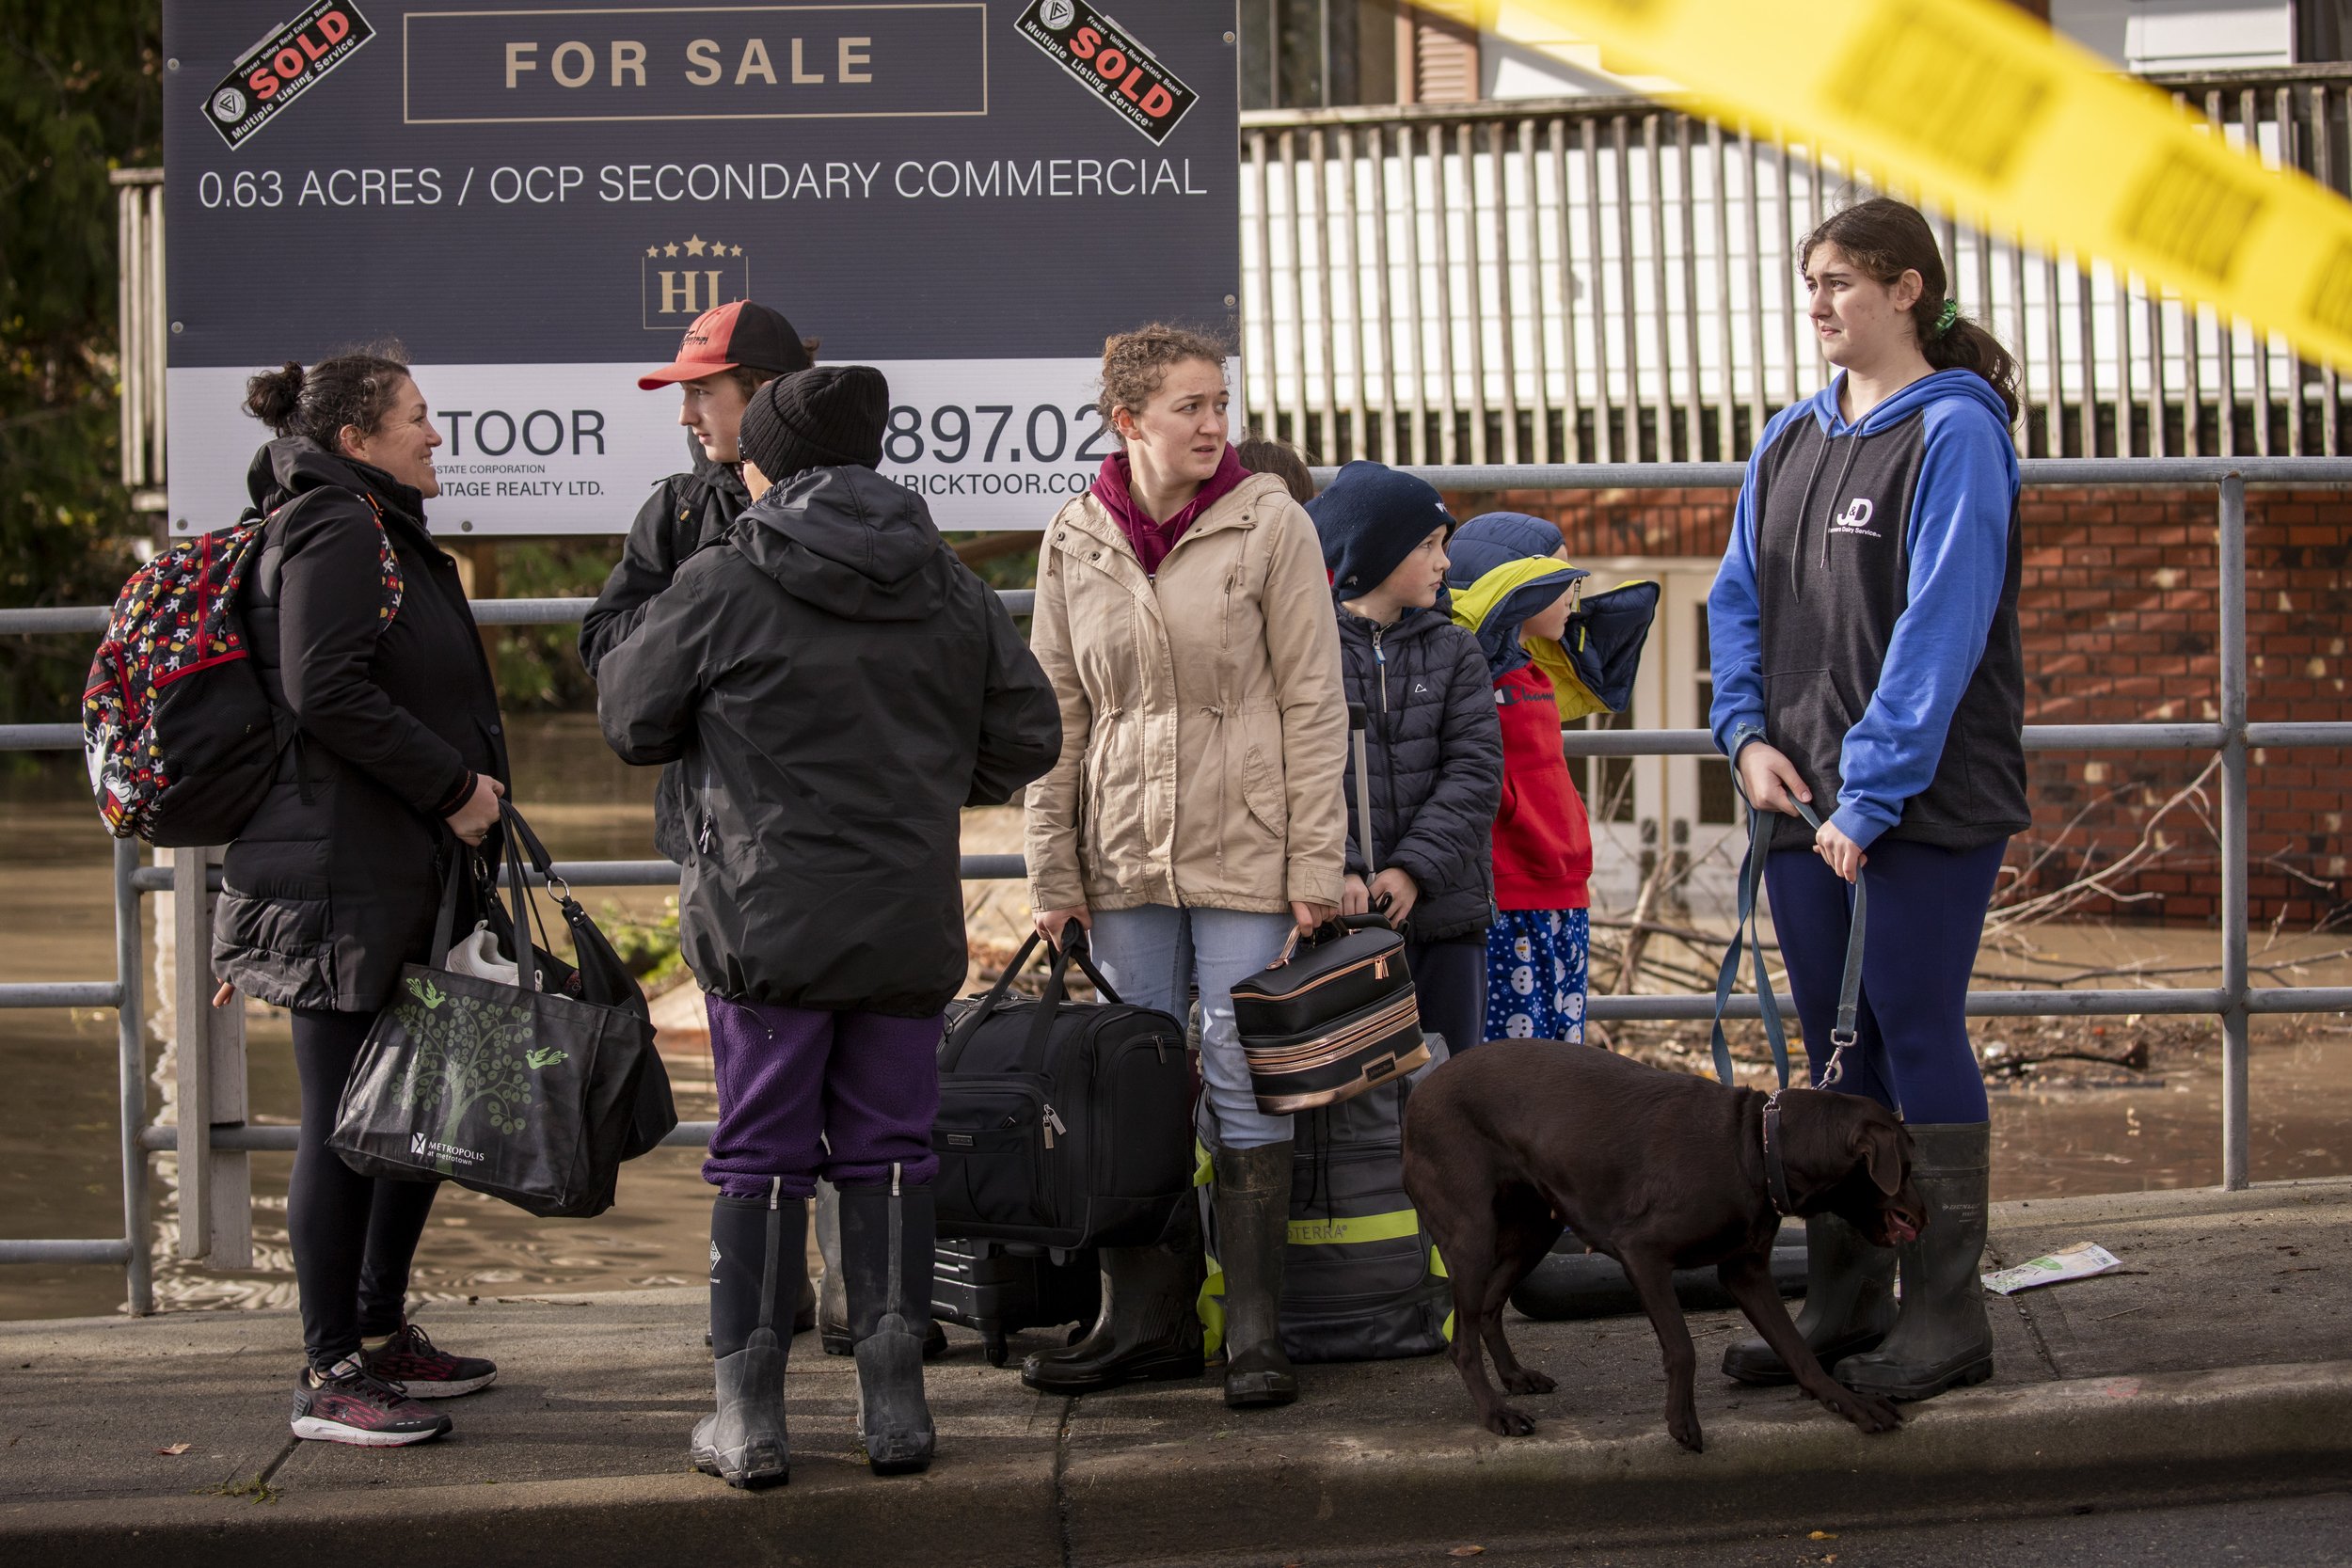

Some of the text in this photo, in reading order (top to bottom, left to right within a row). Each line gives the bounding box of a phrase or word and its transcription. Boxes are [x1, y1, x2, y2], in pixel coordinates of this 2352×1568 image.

[239, 1, 333, 79] Fraser Valley Real Estate Board
[248, 10, 350, 100] SOLD
[505, 37, 873, 88] FOR SALE
[1025, 20, 1068, 59] Multiple
[1071, 58, 1108, 93] Listing
[1087, 15, 1108, 35] Fraser
[1108, 33, 1128, 51] Valley
[1126, 48, 1142, 64] Real
[1141, 59, 1163, 80] Estate
[1162, 77, 1183, 96] Board
[1069, 26, 1173, 118] SOLD
[231, 103, 275, 140] Multiple
[276, 70, 314, 103] Listing
[199, 158, 1207, 208] 0.63 ACRES / OCP SECONDARY COMMERCIAL
[437, 409, 605, 456] TOOR
[433, 464, 546, 474] STATE CORPORATION
[497, 481, 564, 496] REALTY
[569, 481, 604, 495] LTD.
[428, 1141, 485, 1162] METROPOLIS
[436, 1152, 472, 1165] metrotown
